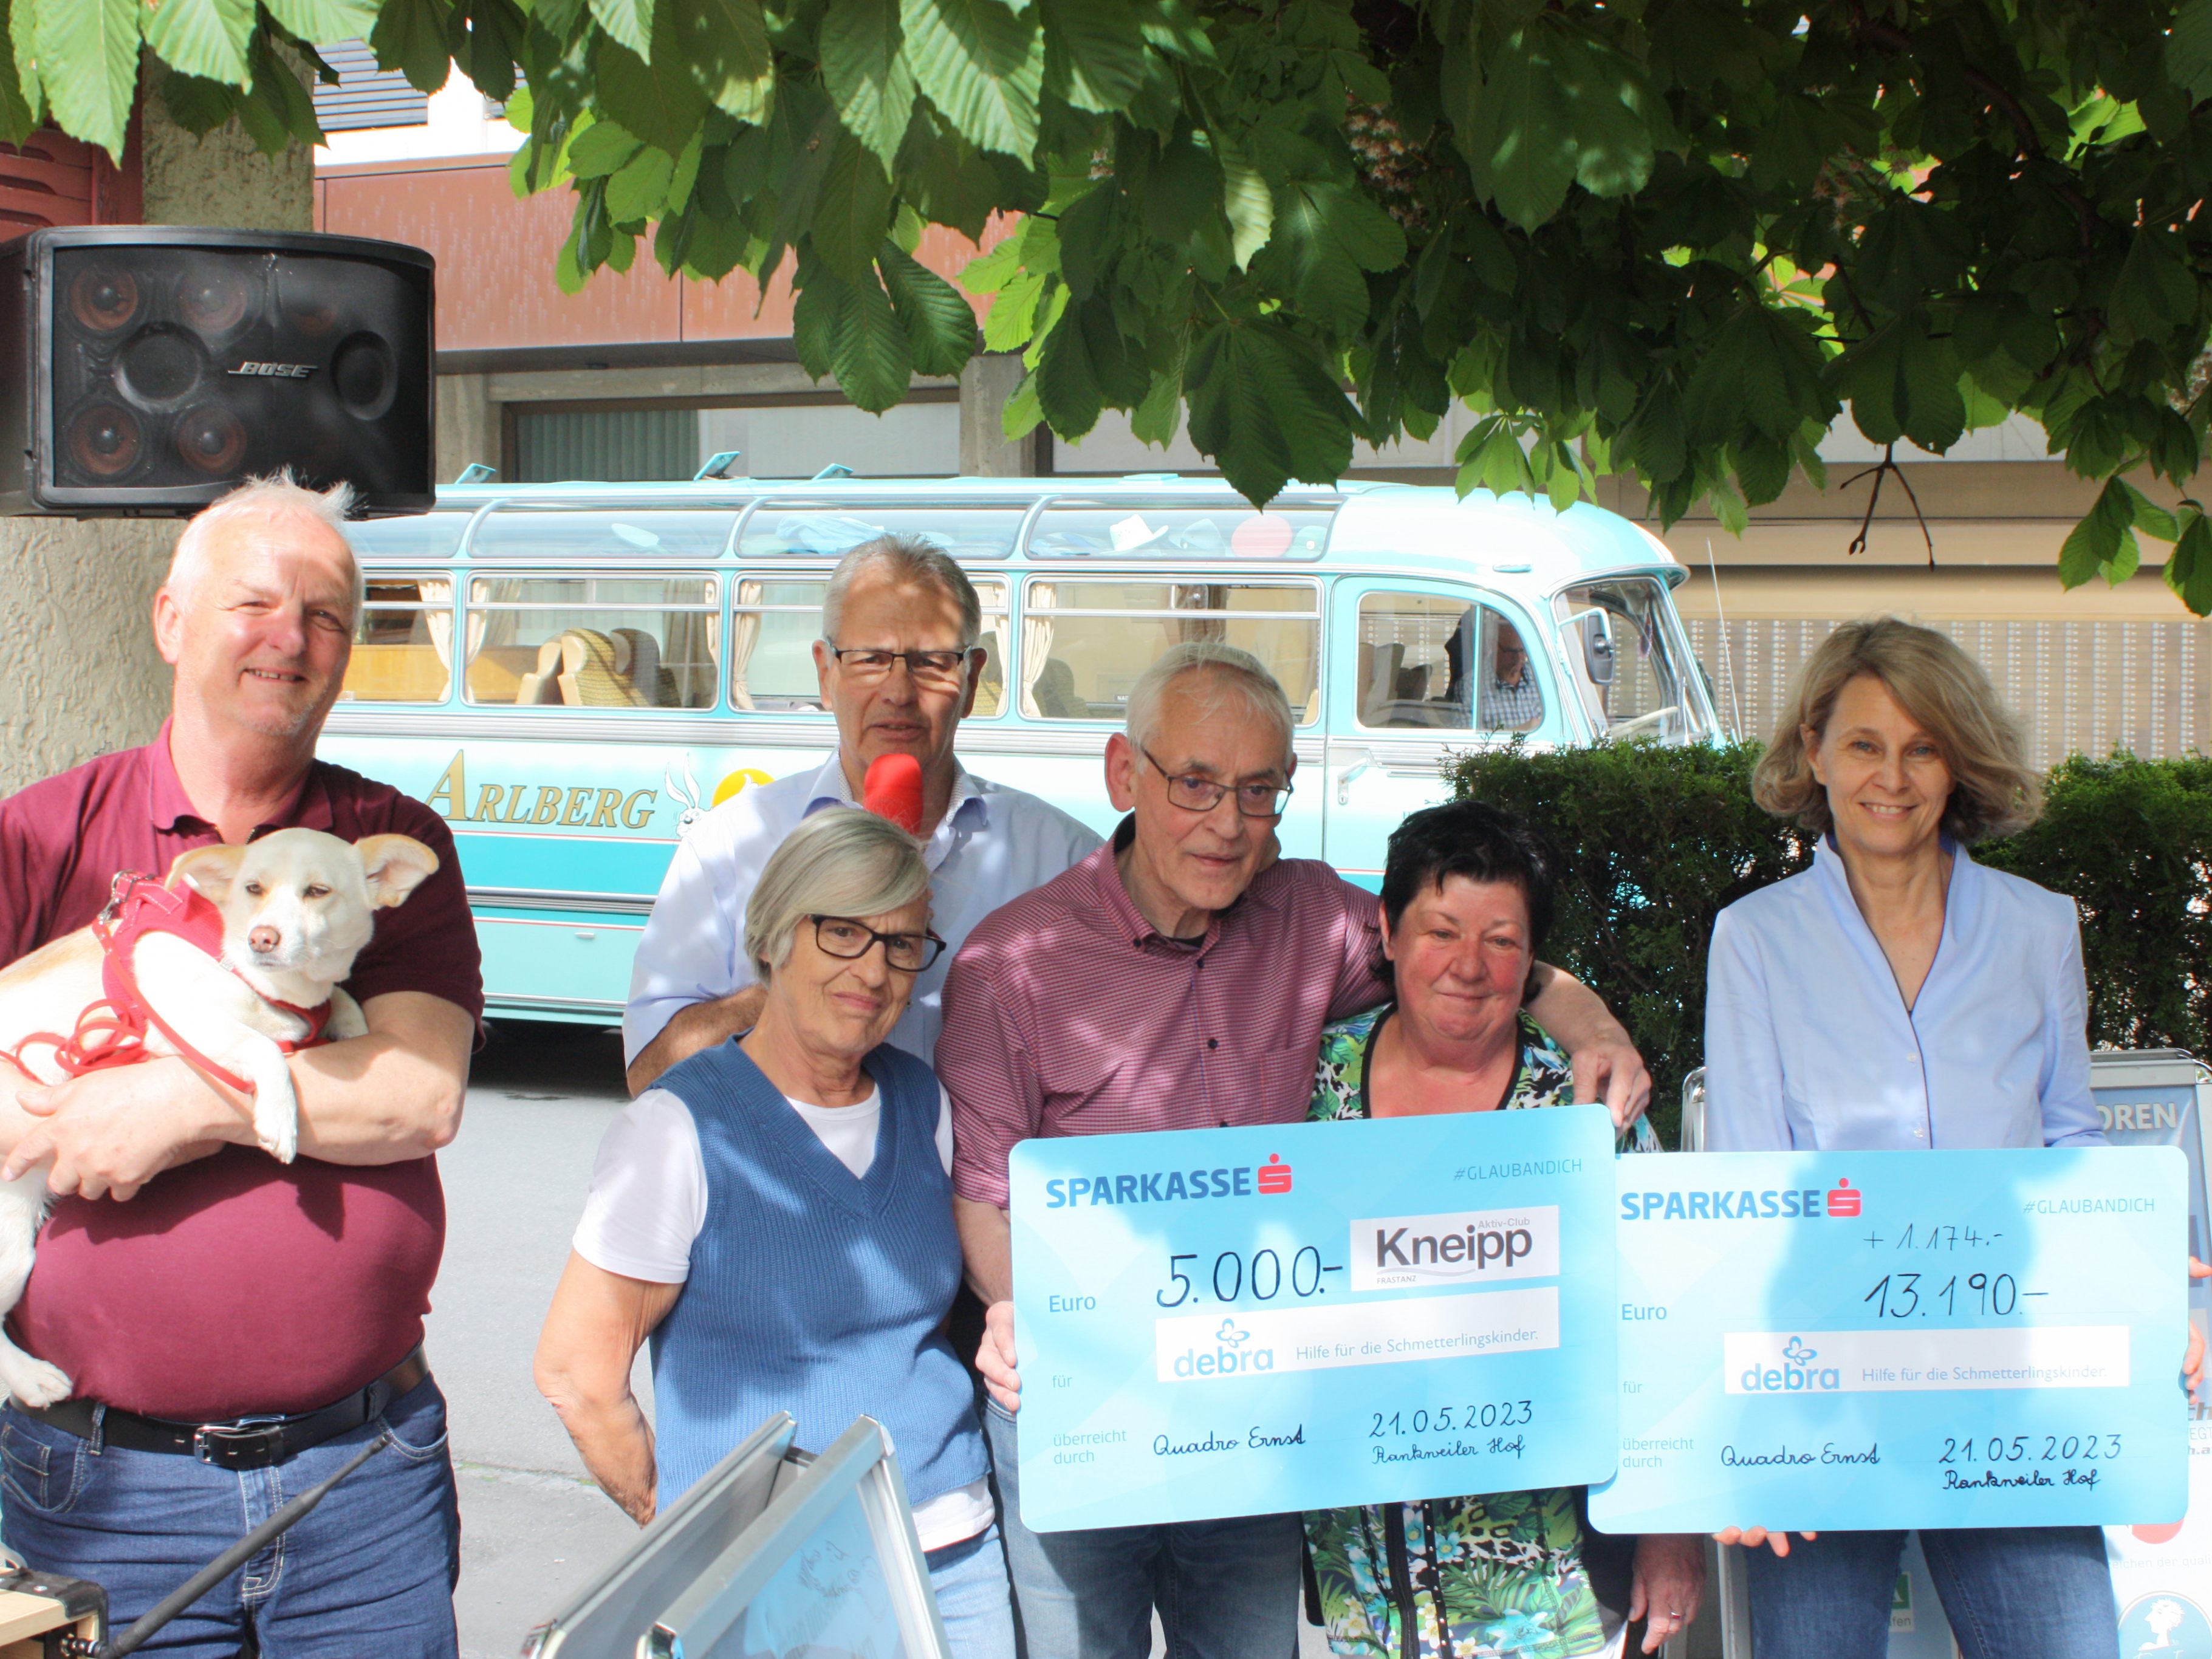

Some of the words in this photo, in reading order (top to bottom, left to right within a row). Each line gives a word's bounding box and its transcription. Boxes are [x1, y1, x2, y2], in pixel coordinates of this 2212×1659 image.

[227, 361, 319, 378] BOSE
[425, 749, 658, 828] ARLBERG
[1454, 1158, 1583, 1181] #GLAUBANDICH
[1046, 1167, 1252, 1208] SPARKASSE
[1621, 1190, 1821, 1220] SPARKASSE
[2022, 1198, 2155, 1214] #GLAUBANDICH
[1478, 1217, 1530, 1229] Aktiv-Club
[1377, 1225, 1532, 1270] Kneipp
[1377, 1275, 1417, 1284] FRASTANZ
[1049, 1294, 1097, 1312] Euro
[1621, 1304, 1667, 1320] Euro
[1296, 1344, 1330, 1360] Hilfe
[1335, 1343, 1355, 1357] für
[1361, 1341, 1382, 1355] die
[1387, 1329, 1539, 1353] Schmetterlingskinder.
[1174, 1346, 1274, 1377] debra
[1052, 1375, 1072, 1388] für
[1741, 1363, 1840, 1390] debra
[1863, 1367, 1896, 1381] Hilfe
[1900, 1368, 1922, 1381] für
[1927, 1368, 1948, 1380] die
[1623, 1381, 1643, 1394] für
[1369, 1400, 1532, 1438] 21.05.2023
[1053, 1429, 1126, 1447] überreicht
[1154, 1431, 1240, 1455] Quadro
[1248, 1423, 1306, 1449] Ernst
[1623, 1437, 1694, 1450] überreicht
[1054, 1450, 1094, 1464] durch
[1721, 1445, 1817, 1466] Quadro
[1821, 1442, 1880, 1465] Ernst
[1939, 1434, 2122, 1463] 21.05.2023
[1623, 1455, 1662, 1468] durch
[2109, 1559, 2153, 1570] eichen
[2182, 1553, 2212, 1567] quali
